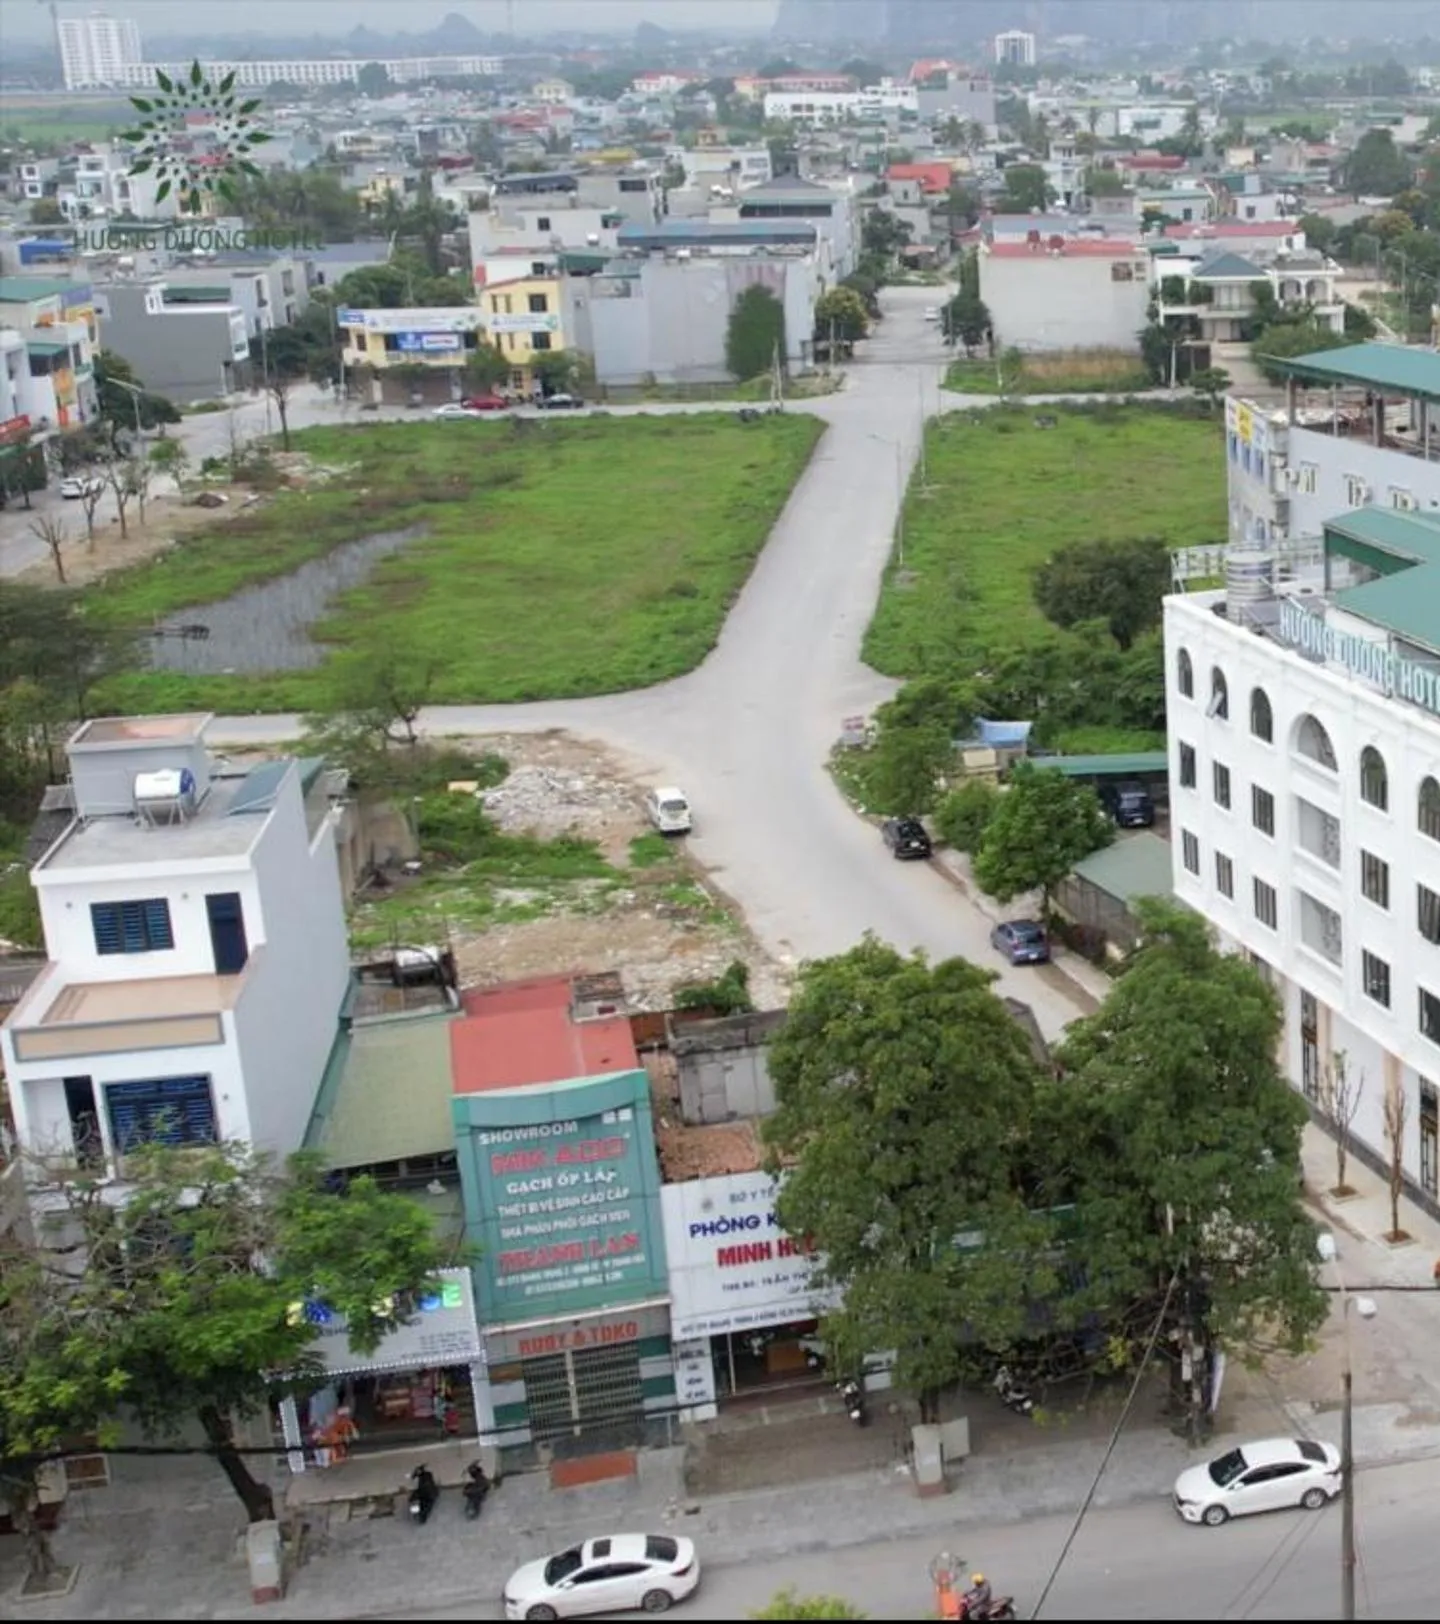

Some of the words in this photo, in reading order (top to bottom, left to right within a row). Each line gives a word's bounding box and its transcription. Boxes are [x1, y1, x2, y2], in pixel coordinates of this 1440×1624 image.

[478, 1121, 579, 1146] SHOWROOM
[689, 1213, 761, 1240] PHÒNG
[717, 1241, 772, 1268] MINH
